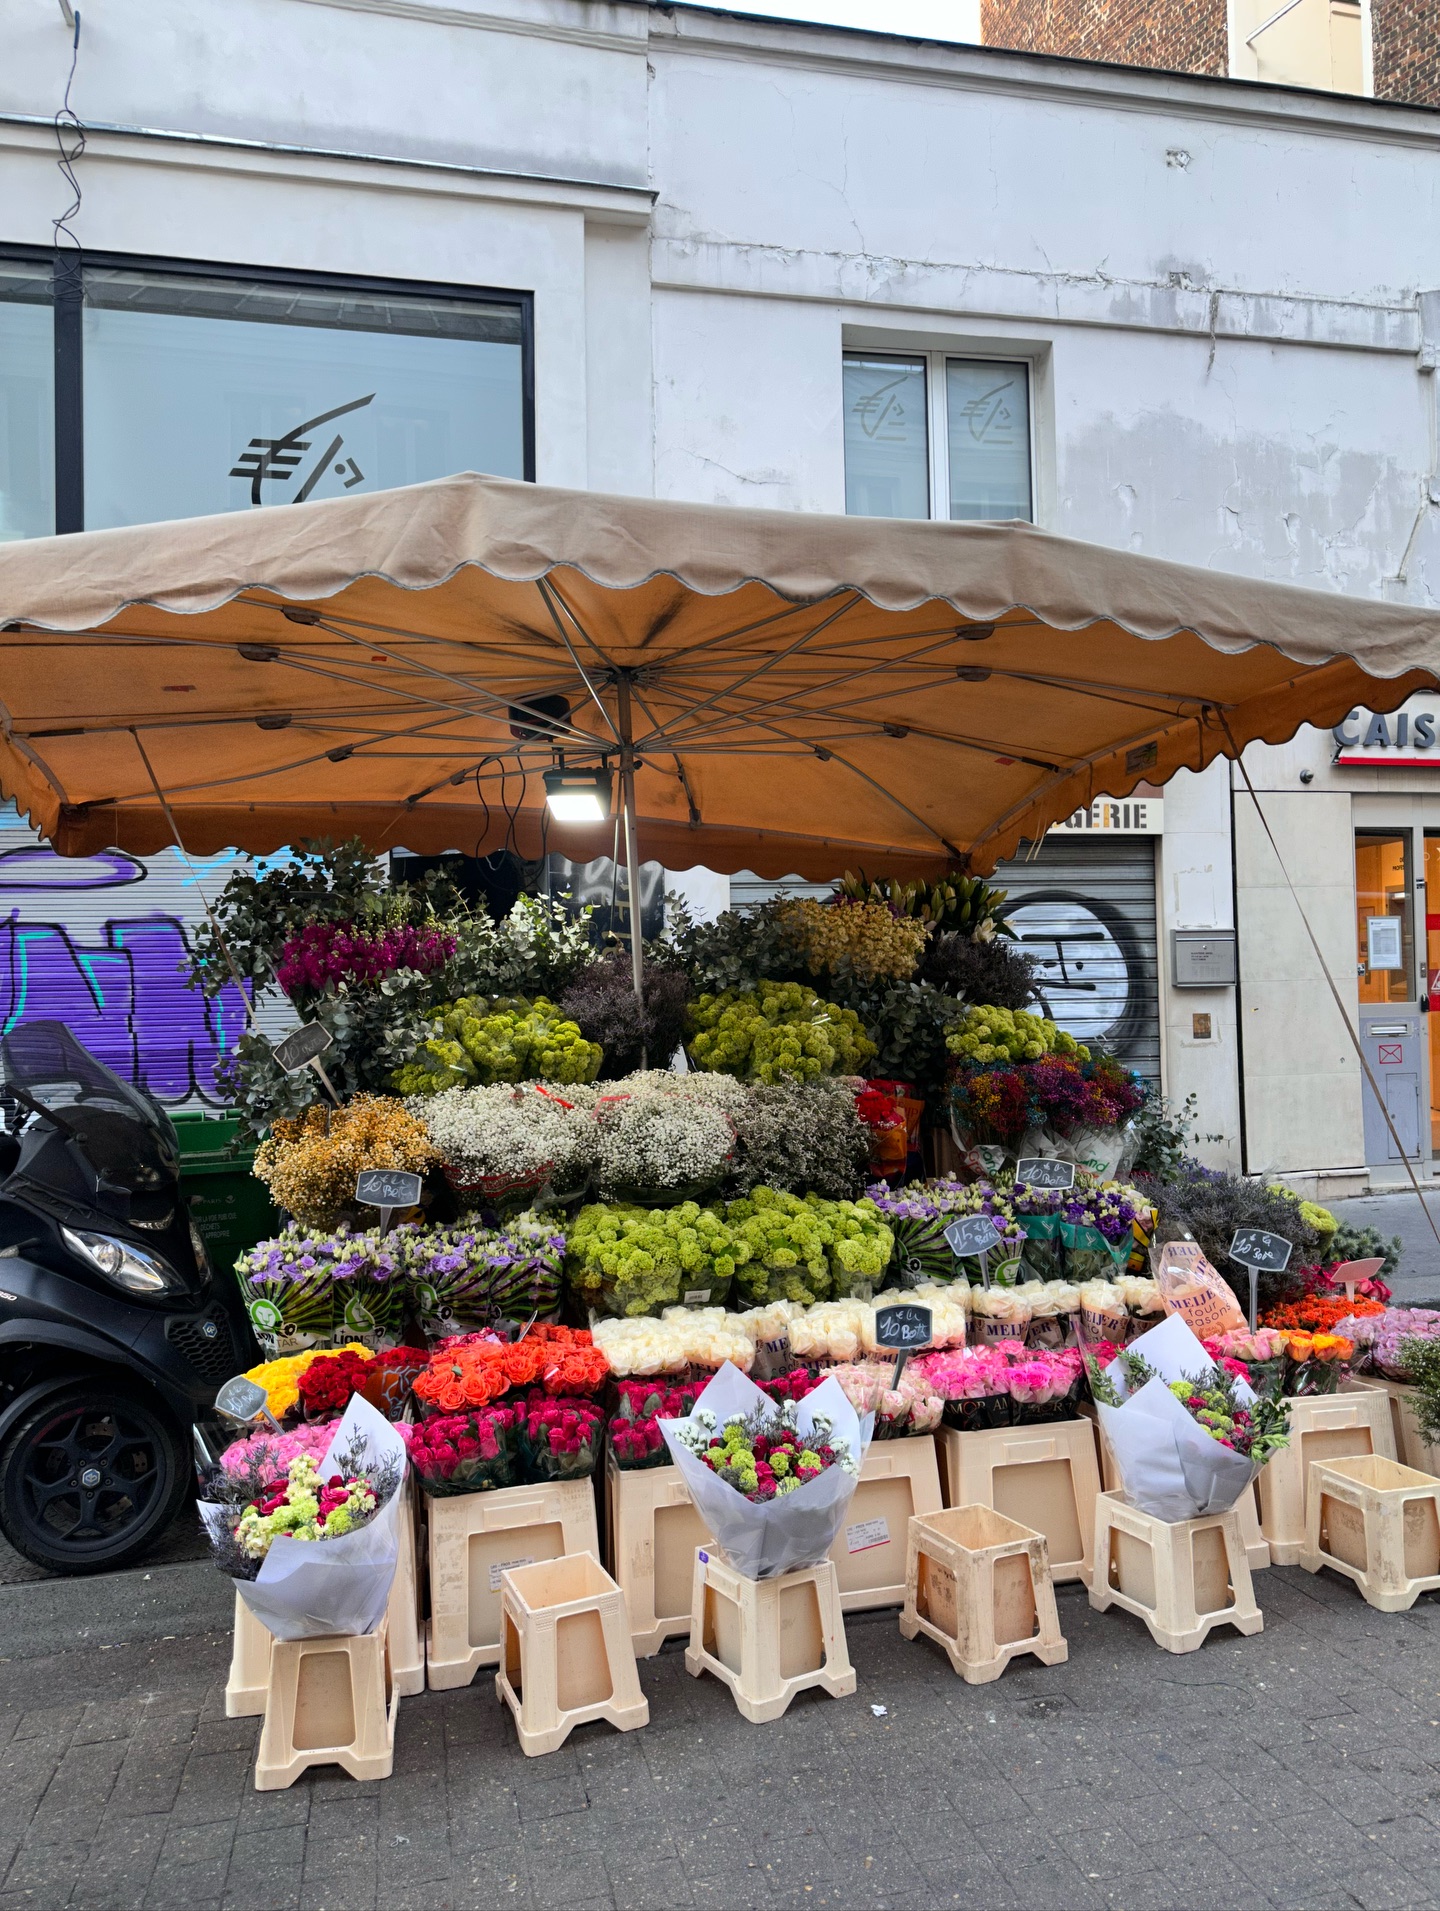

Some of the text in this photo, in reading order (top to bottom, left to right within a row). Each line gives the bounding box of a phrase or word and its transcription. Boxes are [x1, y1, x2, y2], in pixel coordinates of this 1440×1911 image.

[1050, 804, 1147, 828] GERIE
[1020, 1164, 1043, 1180] 10
[363, 1174, 382, 1192] 10
[1185, 1303, 1231, 1327] easons
[1188, 1301, 1217, 1317] four
[881, 1316, 900, 1339] 10
